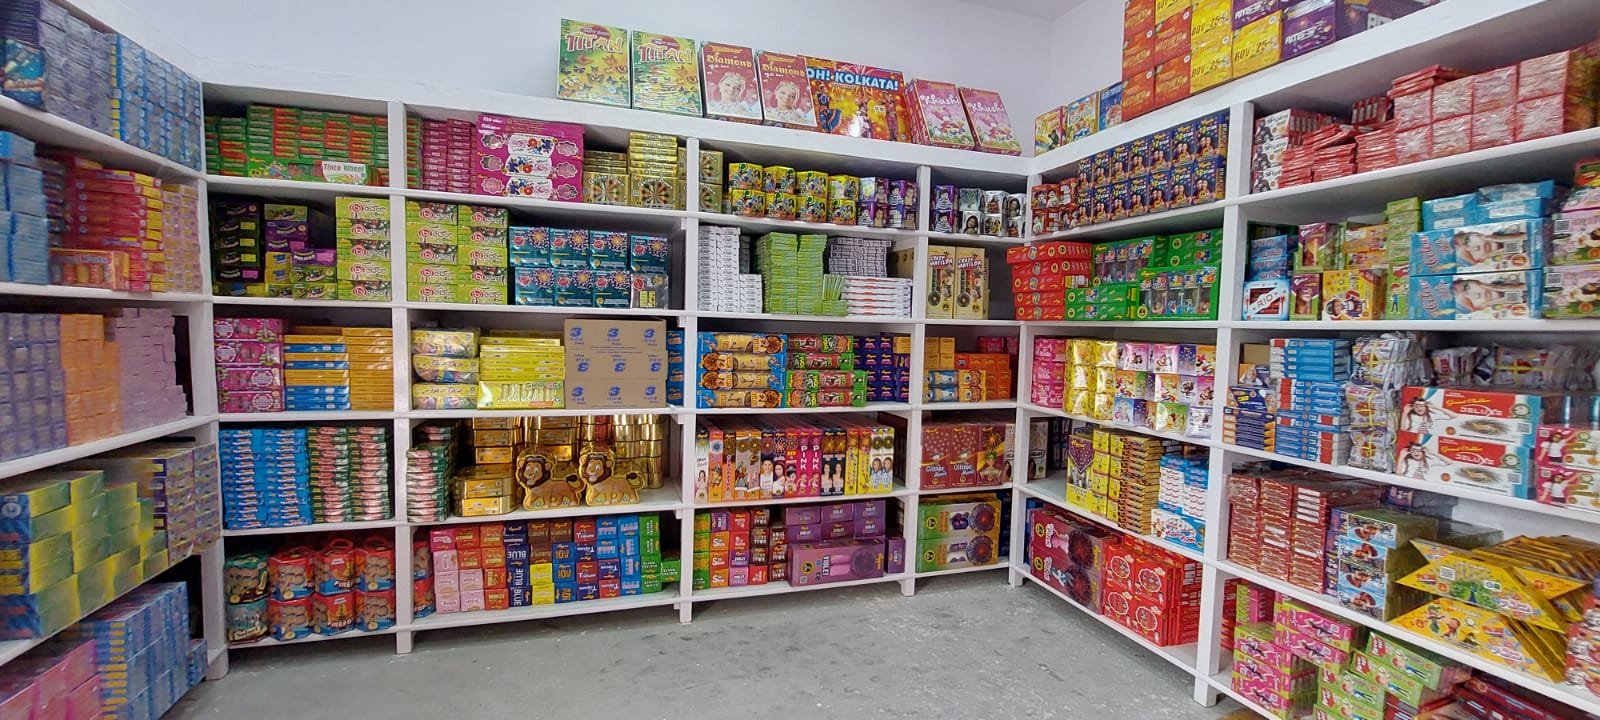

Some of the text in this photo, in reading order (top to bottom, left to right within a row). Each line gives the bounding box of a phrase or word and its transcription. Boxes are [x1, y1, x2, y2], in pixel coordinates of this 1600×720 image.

[564, 31, 624, 55] TITAN
[636, 44, 694, 66] TITAN
[806, 67, 899, 92] OH! KOLKATA!
[800, 445, 808, 470] PINK
[812, 445, 820, 470] PINK
[507, 550, 527, 560] BLUE
[513, 589, 523, 608] BLUE
